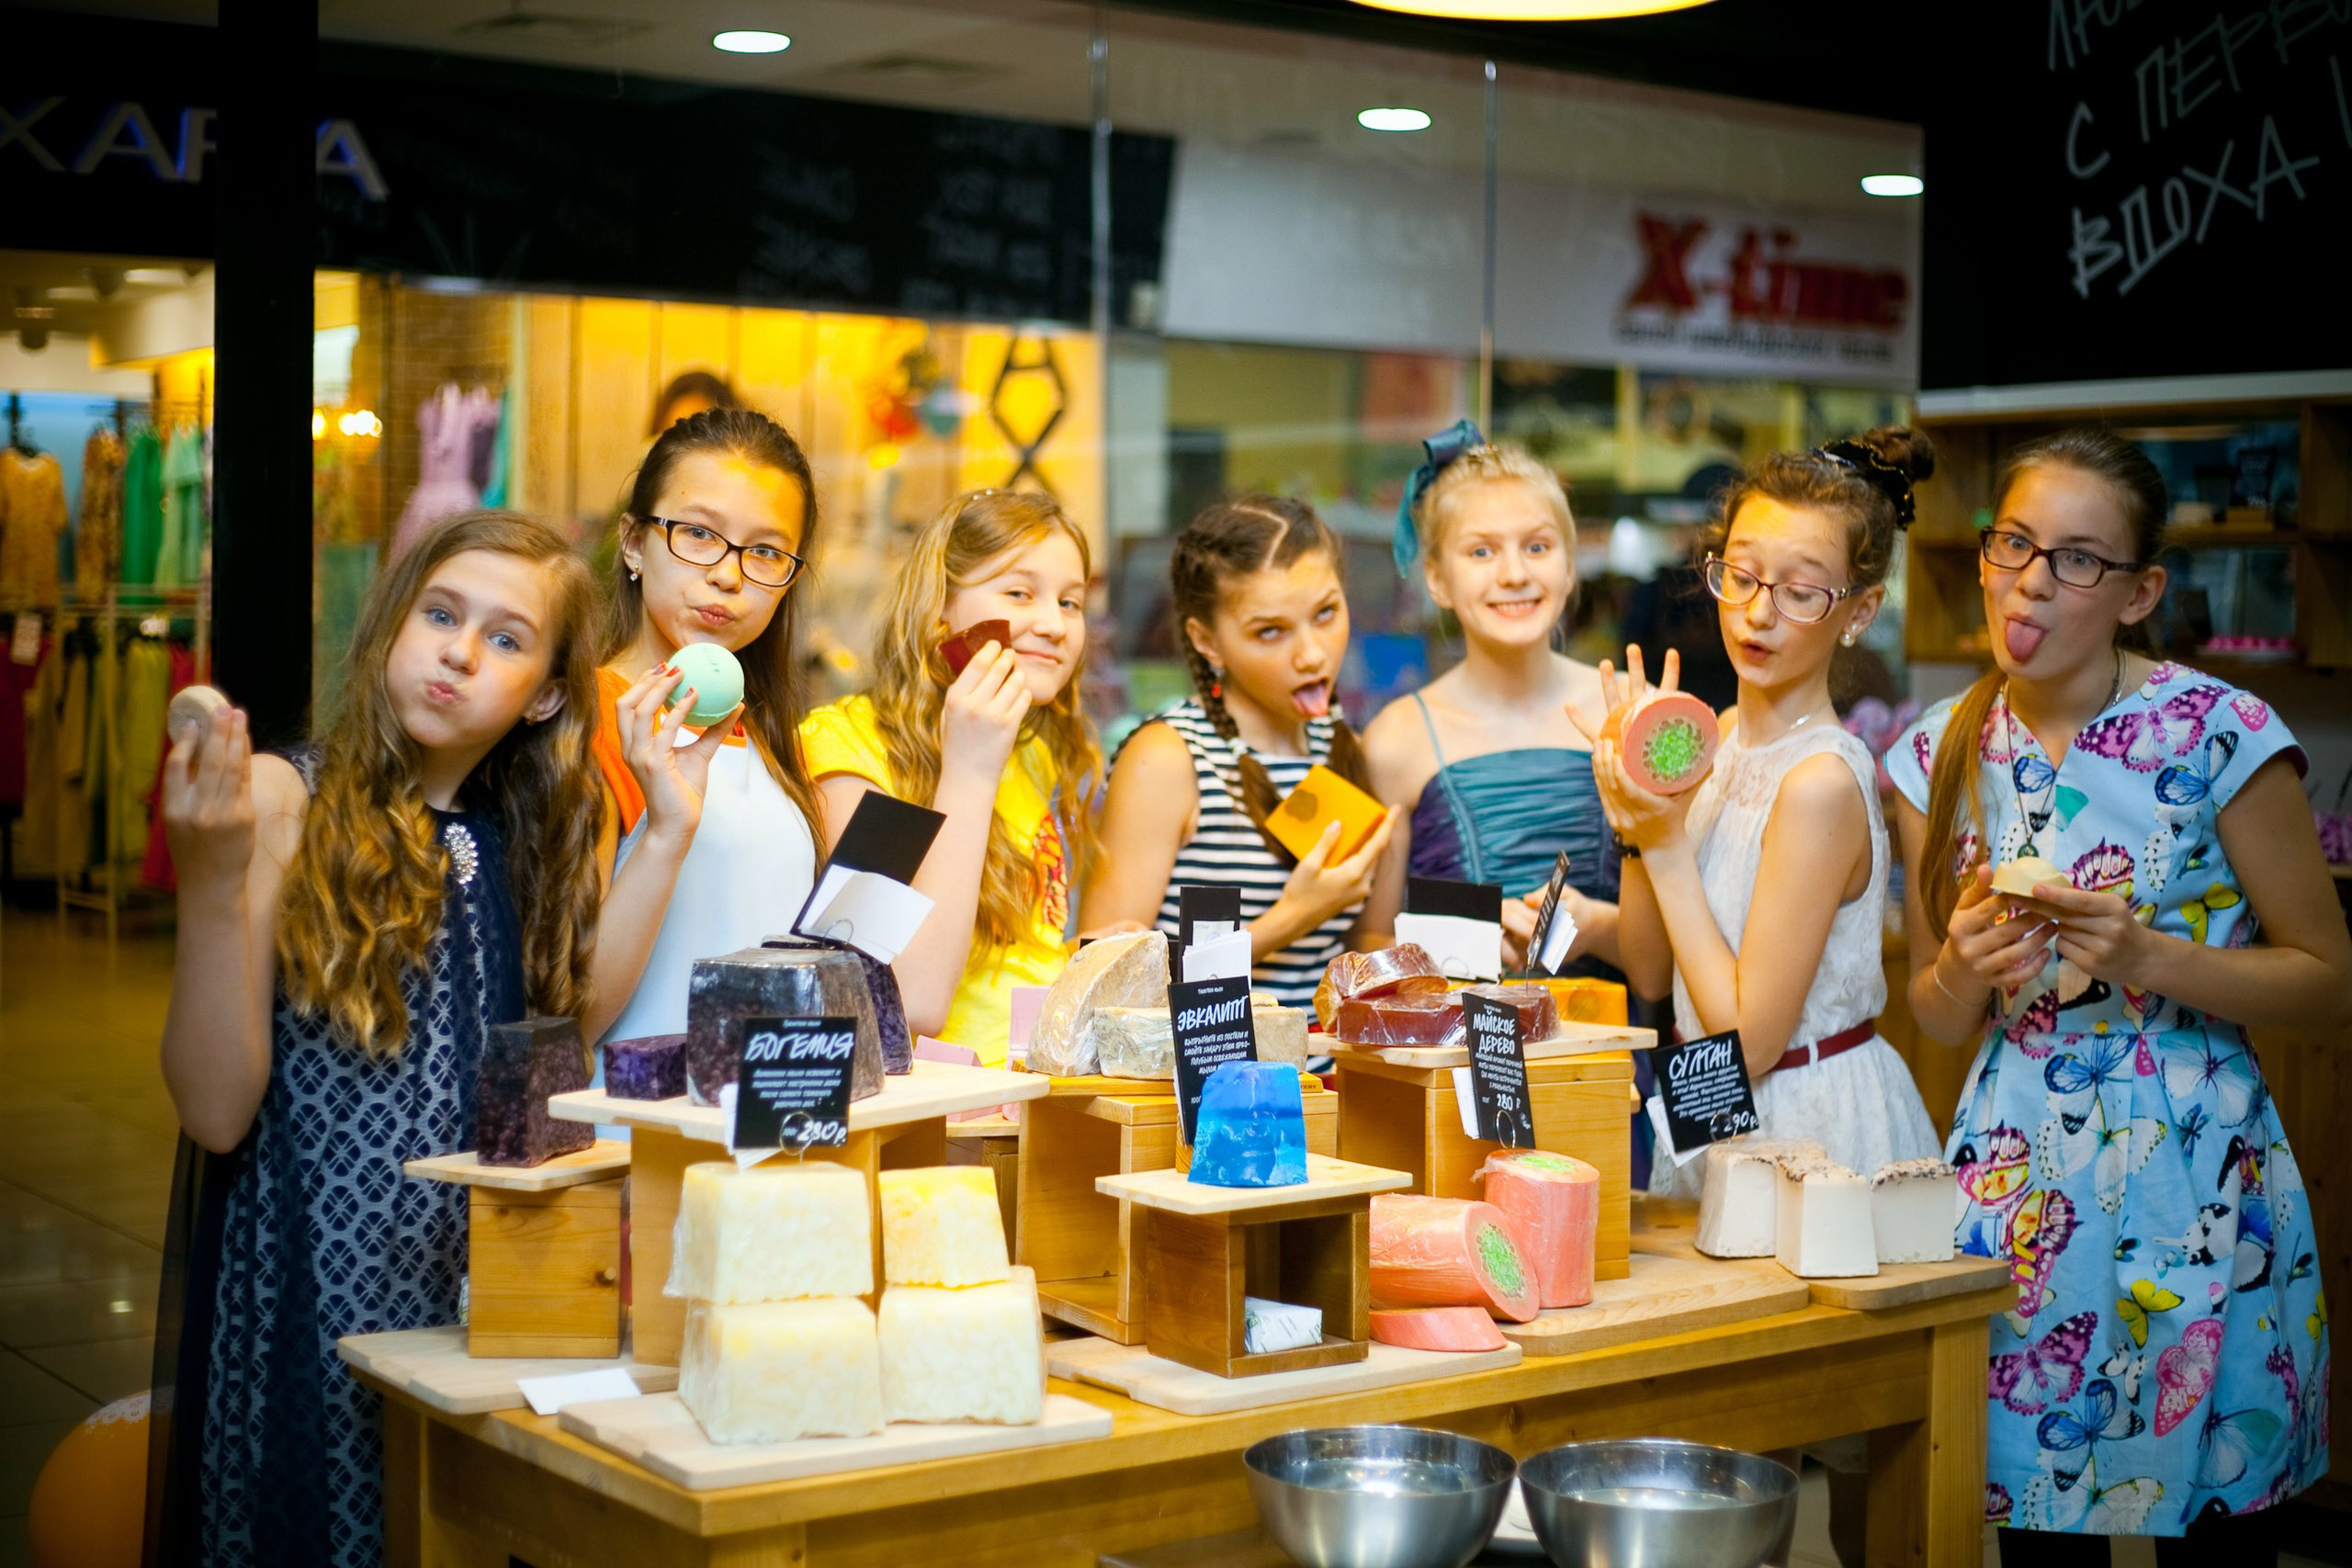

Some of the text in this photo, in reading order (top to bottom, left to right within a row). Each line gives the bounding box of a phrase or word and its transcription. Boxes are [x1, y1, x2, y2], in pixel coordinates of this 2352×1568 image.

[1177, 995, 1250, 1032] ЭВКАЛИПТ
[1473, 1010, 1516, 1036] МАЙСКОЕ
[743, 1032, 854, 1061] БОГЕМИЯ
[1478, 1033, 1516, 1055] ДЕРЕВО
[1497, 1093, 1513, 1111] 280
